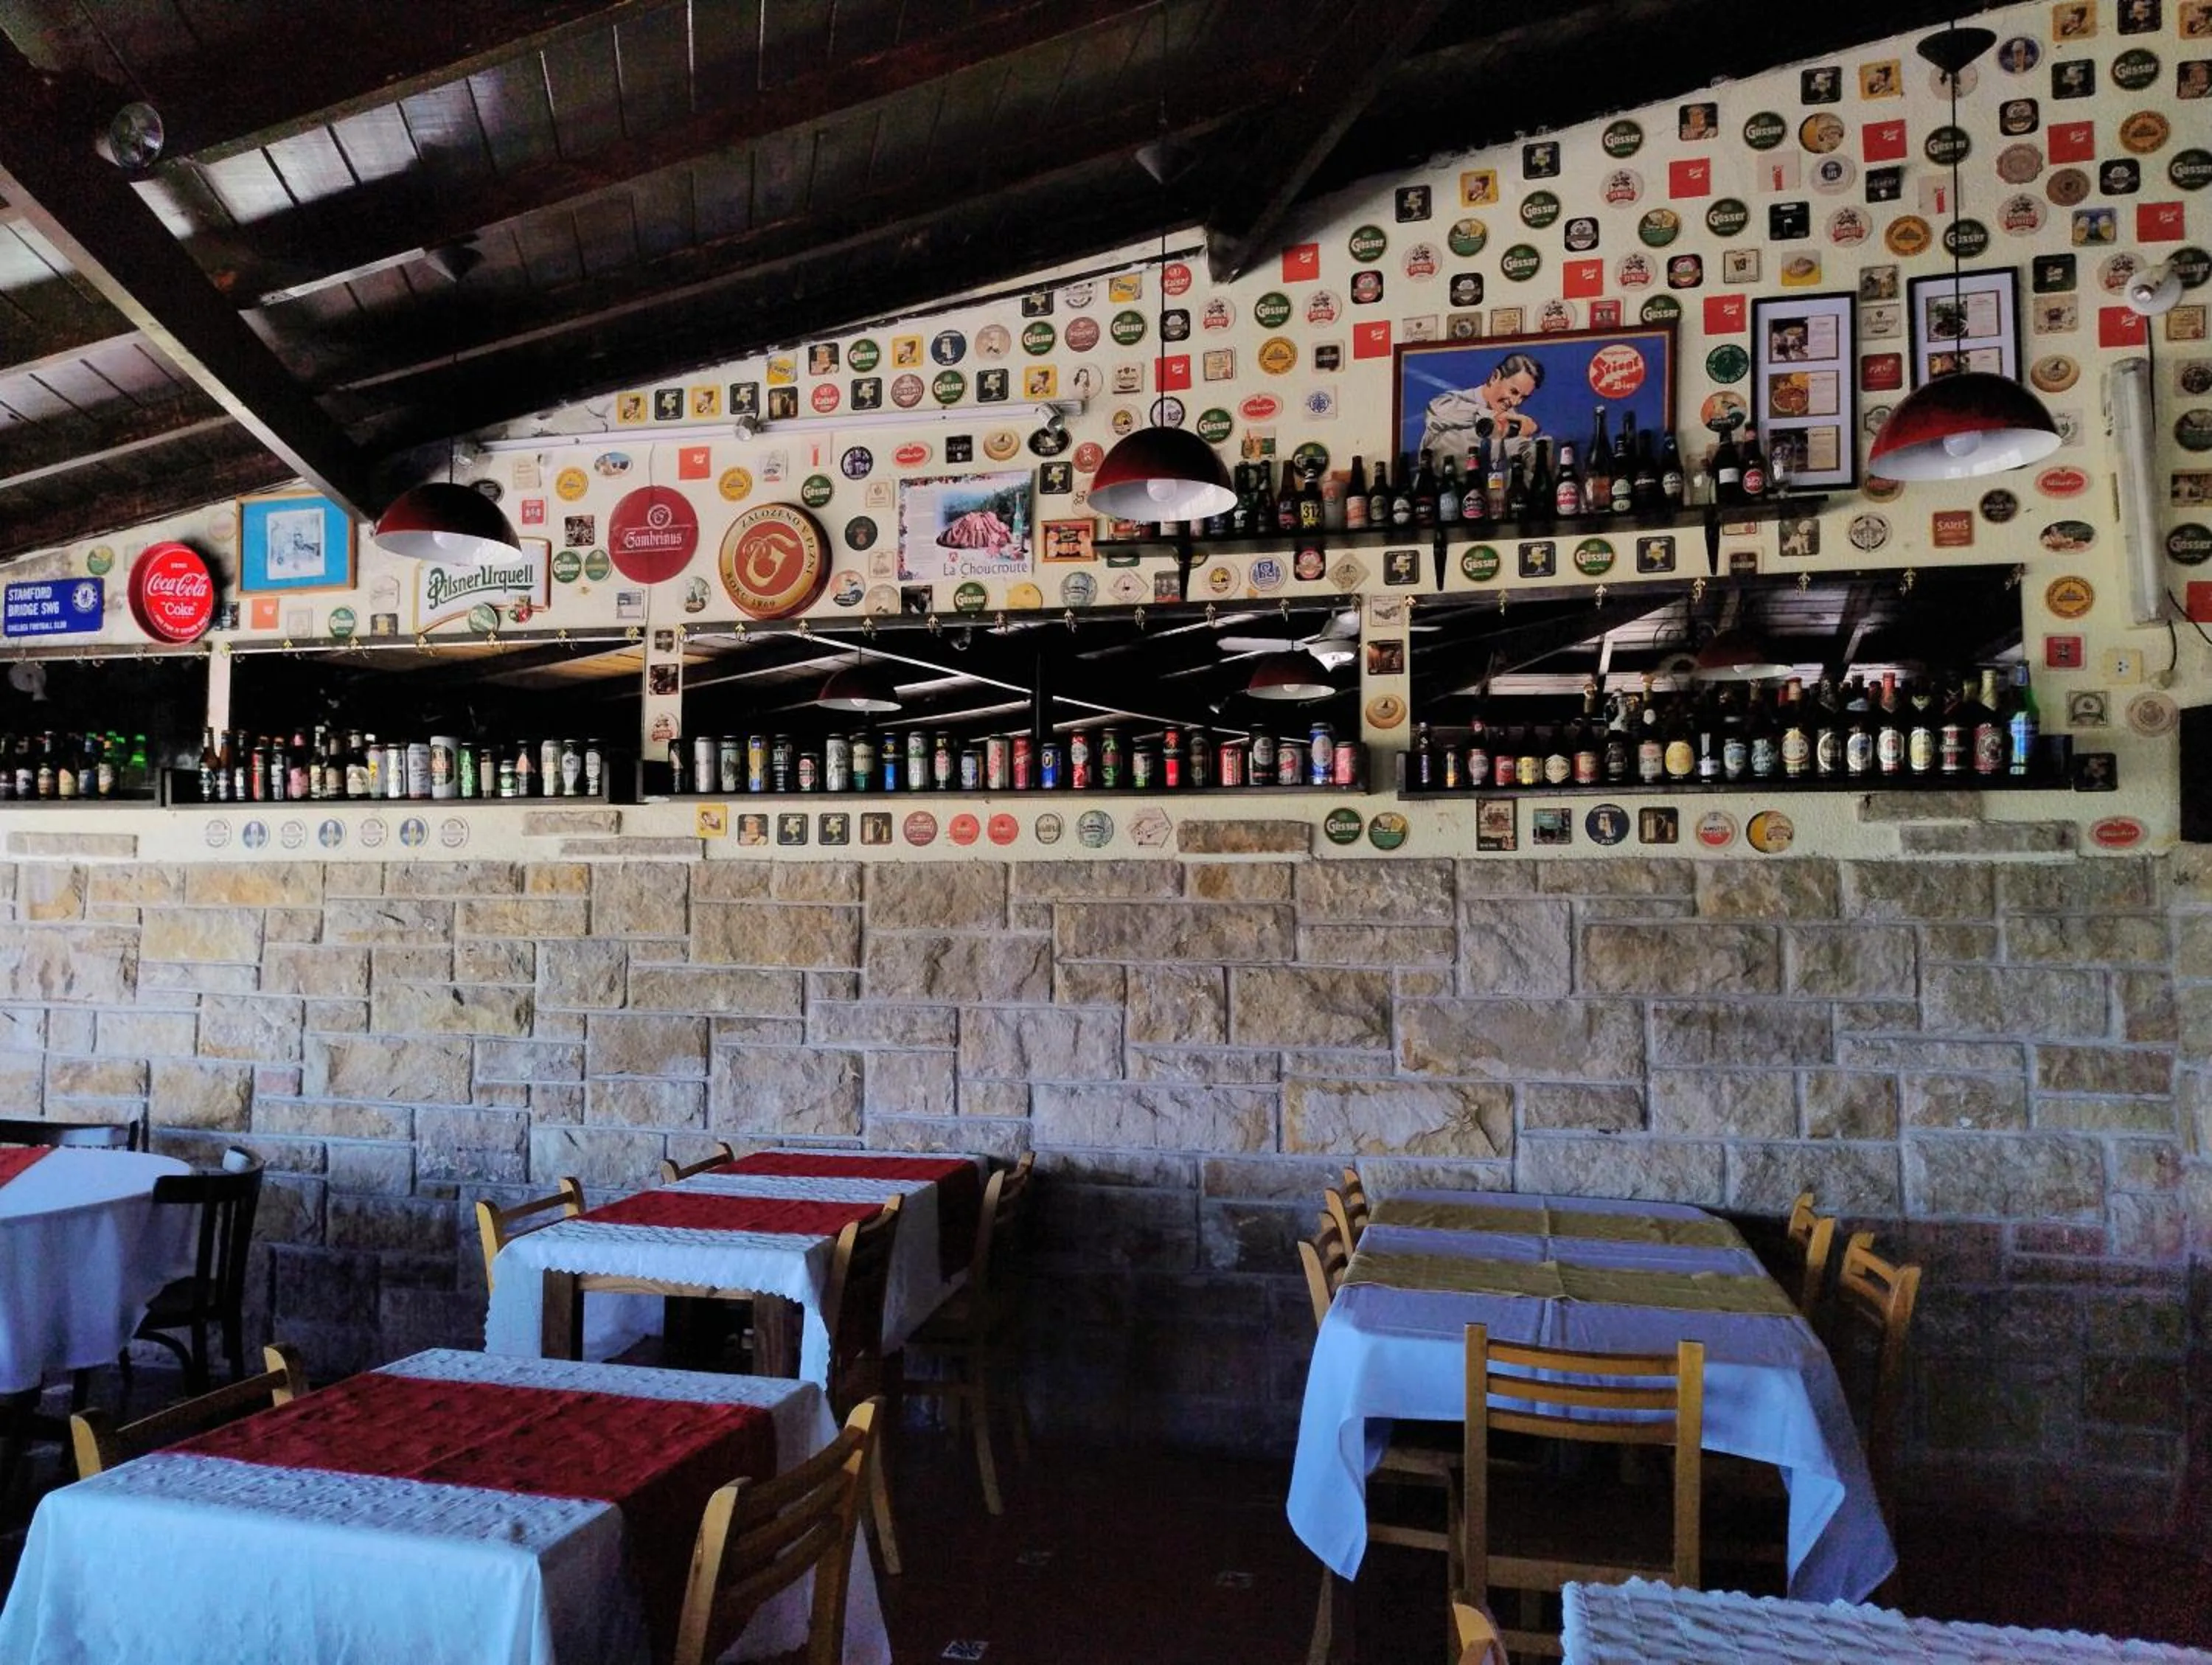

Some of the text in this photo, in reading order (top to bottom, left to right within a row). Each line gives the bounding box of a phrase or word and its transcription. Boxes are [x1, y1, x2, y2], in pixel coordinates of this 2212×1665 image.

[625, 532, 683, 548] Gambrinus
[943, 560, 1027, 579] La Choucroute
[8, 586, 52, 601] STAMFORD
[427, 563, 535, 609] Pilsner Urquell
[8, 602, 38, 617] BRIDGE
